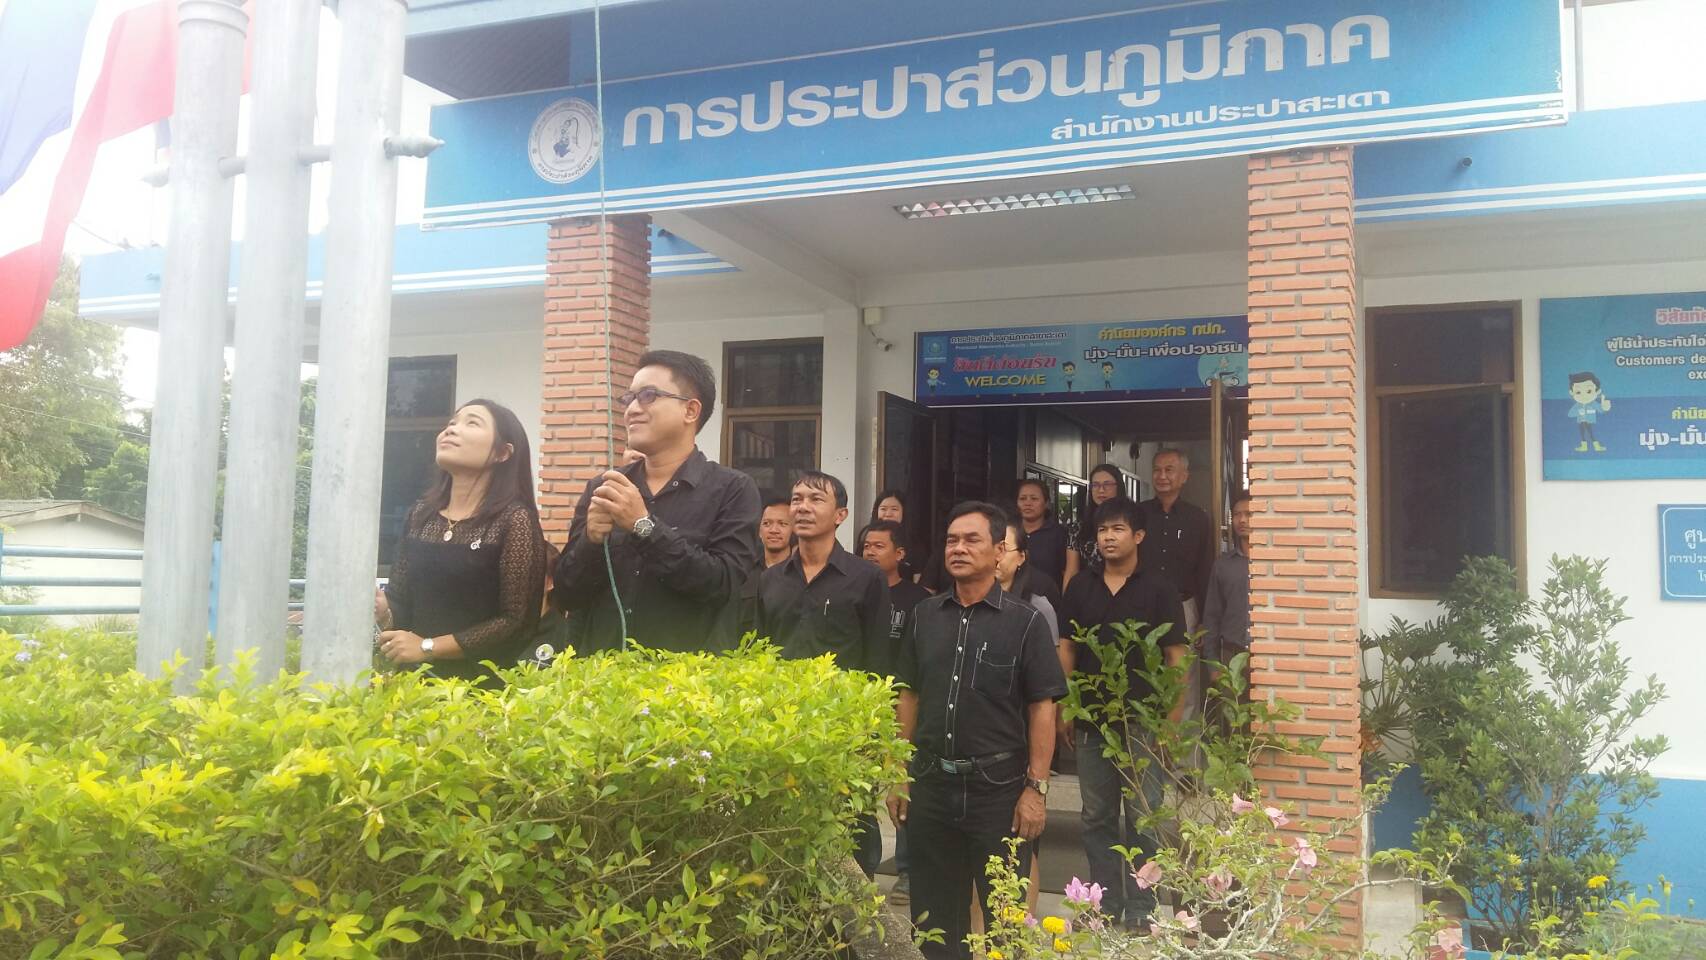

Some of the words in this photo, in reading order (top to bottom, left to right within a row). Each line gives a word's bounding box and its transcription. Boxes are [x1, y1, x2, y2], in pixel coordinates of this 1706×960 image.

[621, 13, 1390, 148] การประปาส่วนภูมิภาค
[1051, 89, 1390, 141] สำนักงานประปาสะเดา
[1616, 355, 1686, 367] Customers
[964, 373, 1047, 388] WELCOME
